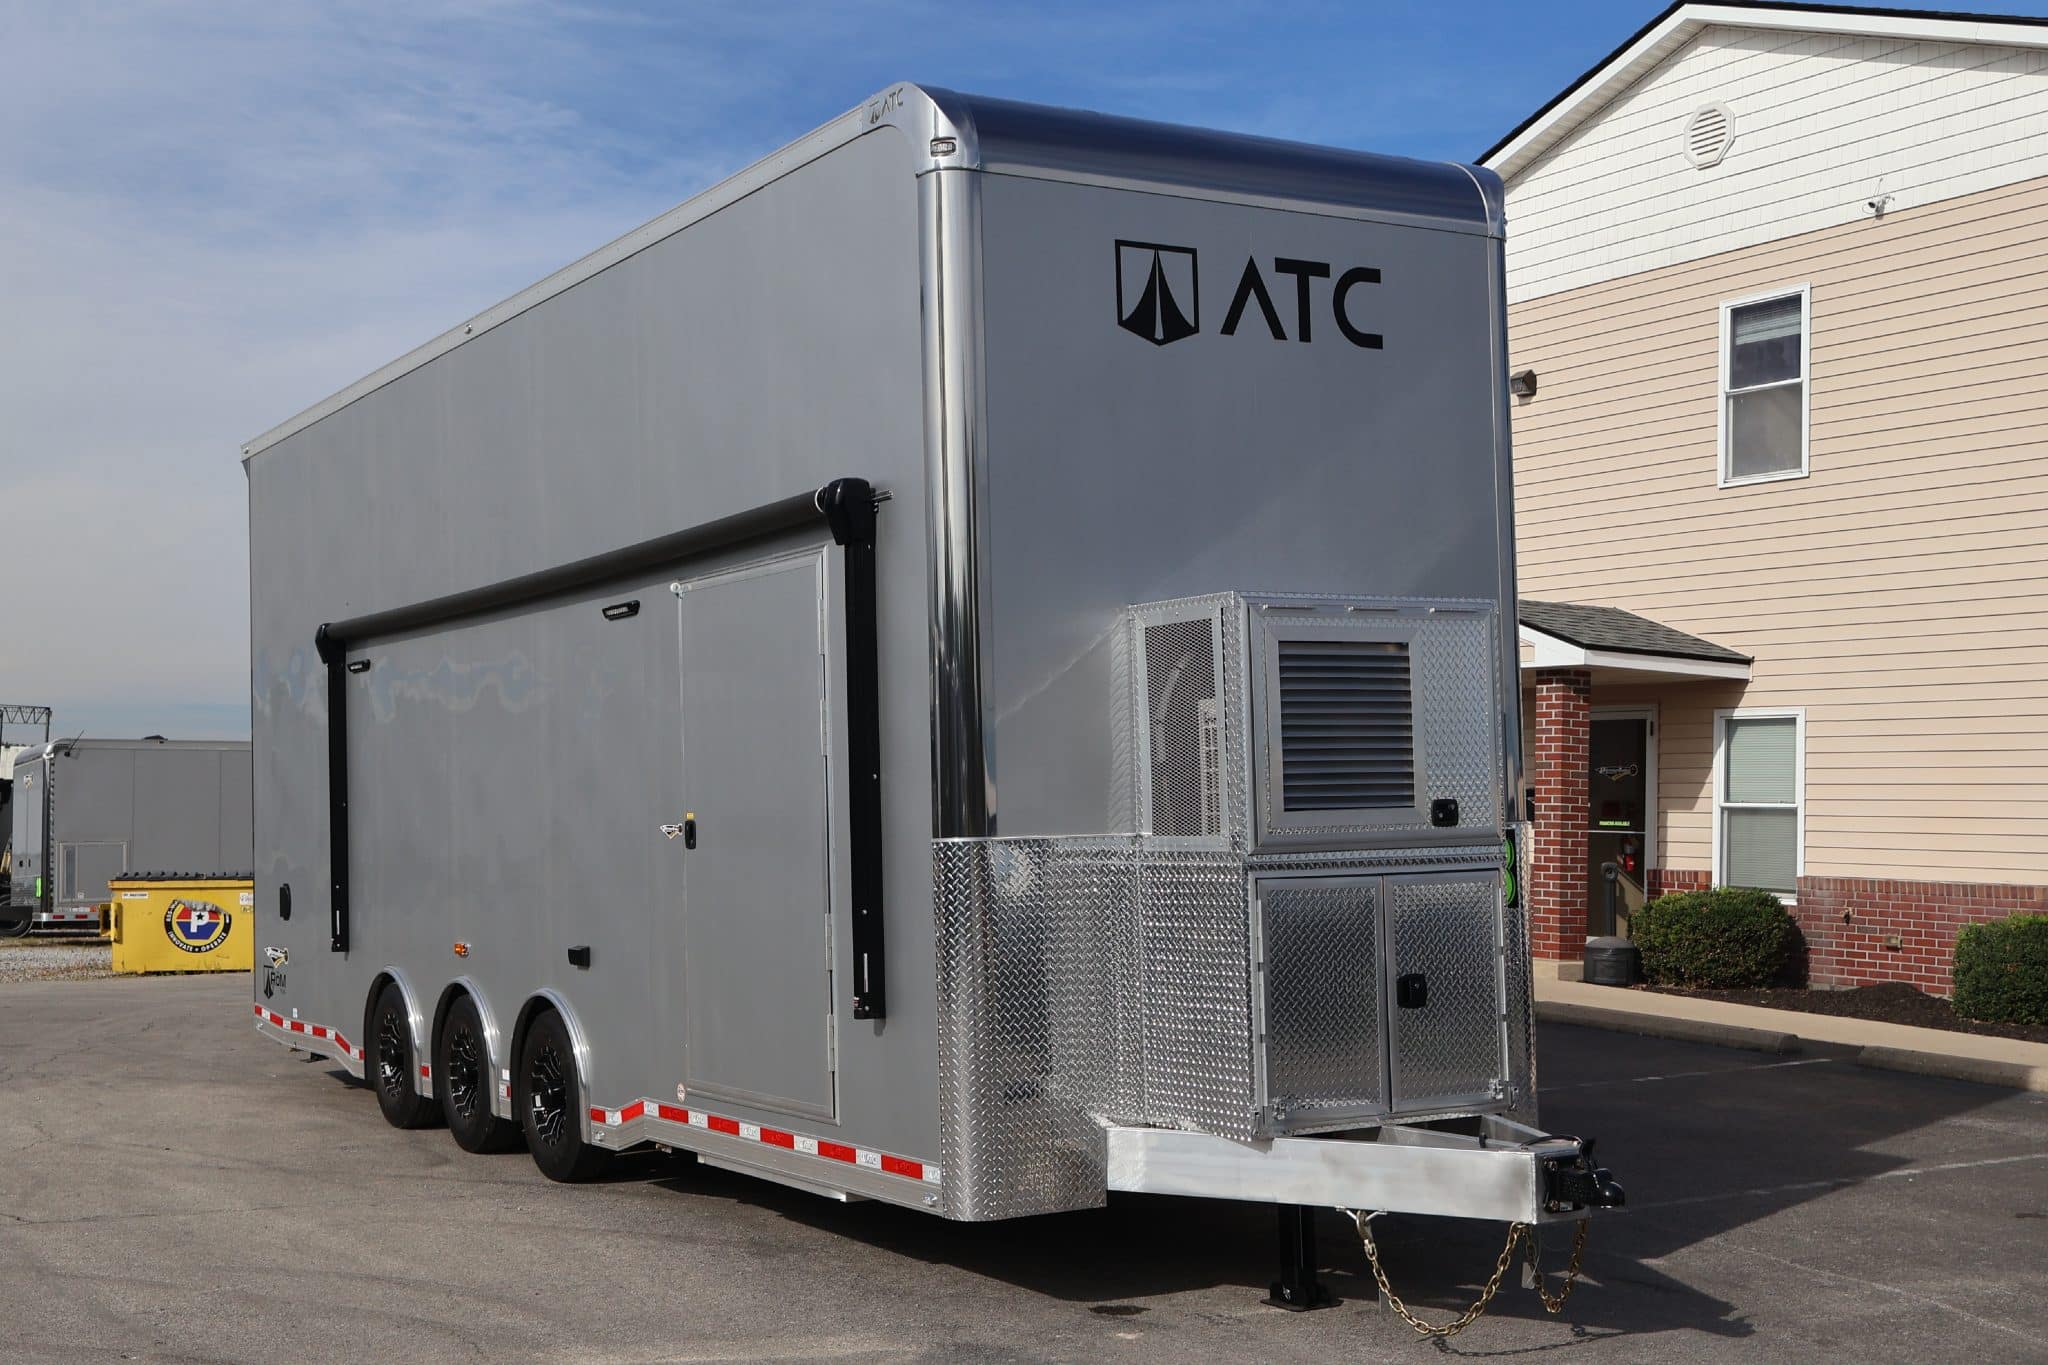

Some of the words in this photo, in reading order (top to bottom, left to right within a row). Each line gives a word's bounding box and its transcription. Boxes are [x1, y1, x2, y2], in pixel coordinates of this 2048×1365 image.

[882, 88, 904, 116] ATC
[1220, 255, 1384, 350] ATC
[168, 931, 193, 952] INNOVATE
[200, 932, 227, 952] OPERATE
